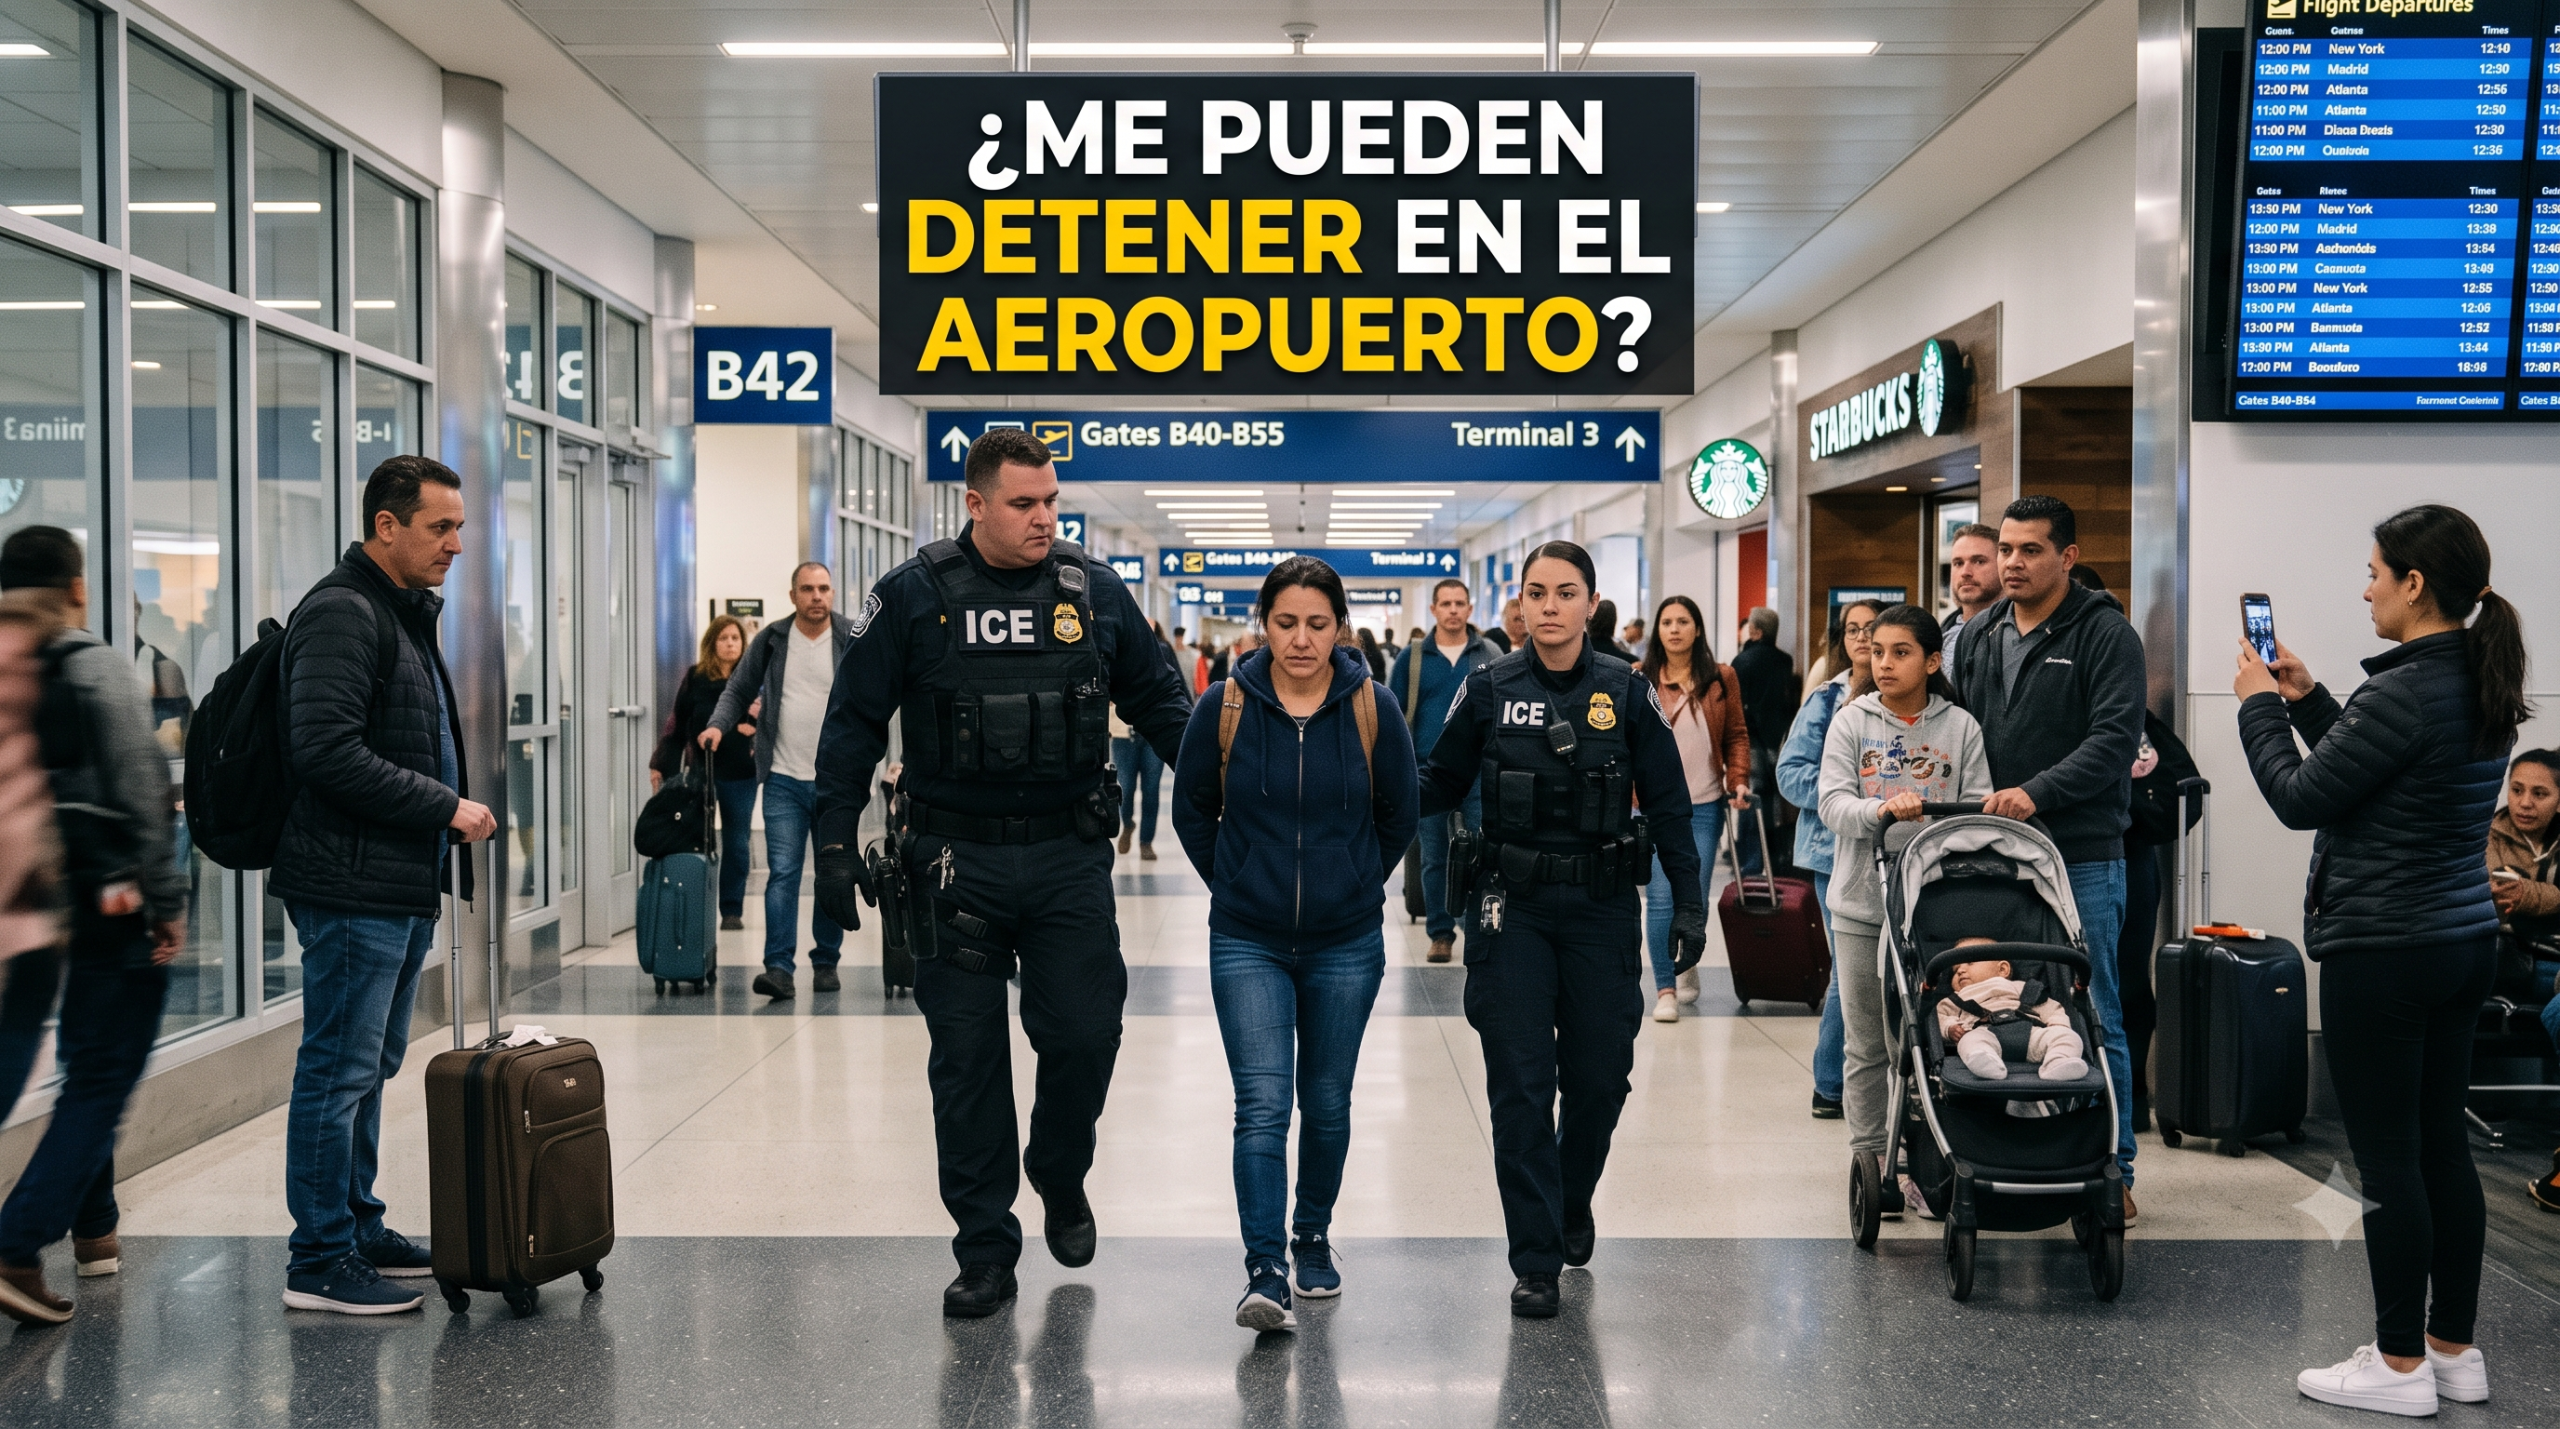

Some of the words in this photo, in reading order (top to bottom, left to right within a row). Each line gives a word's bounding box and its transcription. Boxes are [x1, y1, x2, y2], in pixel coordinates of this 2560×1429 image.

[2260, 43, 2290, 55] 12:00
[2292, 43, 2312, 55] PM
[2328, 43, 2355, 55] New
[2358, 43, 2385, 55] York
[2290, 63, 2310, 75] PM
[2327, 63, 2369, 75] Madrid
[2257, 83, 2287, 96] 12:00
[2289, 83, 2309, 96] PM
[2256, 104, 2286, 116] 11:00
[2288, 104, 2308, 116] PM
[2254, 124, 2284, 136] 11:00
[2286, 124, 2306, 136] PM
[2253, 144, 2283, 156] 12:00
[2285, 144, 2305, 156] PM
[2469, 186, 2497, 195] Times
[2281, 203, 2301, 215] PM
[2318, 203, 2345, 215] New
[2347, 203, 2373, 215] York
[2248, 223, 2278, 235] 12:00
[2280, 223, 2300, 235] PM
[2316, 223, 2358, 235] Madrid
[2280, 242, 2300, 254] PM
[2279, 262, 2299, 275] PM
[2246, 282, 2276, 294] 13:00
[2278, 282, 2298, 294] PM
[2313, 282, 2340, 294] New
[2341, 282, 2368, 294] York
[2245, 302, 2275, 314] 13:00
[2277, 302, 2297, 314] PM
[2243, 321, 2273, 333] 13:00
[2275, 321, 2295, 333] PM
[2274, 341, 2294, 353] PM
[2273, 361, 2293, 373] PM
[707, 350, 819, 401] B42
[2238, 395, 2269, 406] Gates
[1810, 372, 1912, 462] STARBUCKS
[1080, 421, 1161, 446] Gates
[1170, 421, 1285, 446] B40-B55
[1451, 421, 1574, 447] Terminal
[1583, 421, 1600, 447] 3
[965, 609, 1035, 644] ICE
[1502, 700, 1546, 726] ICE
